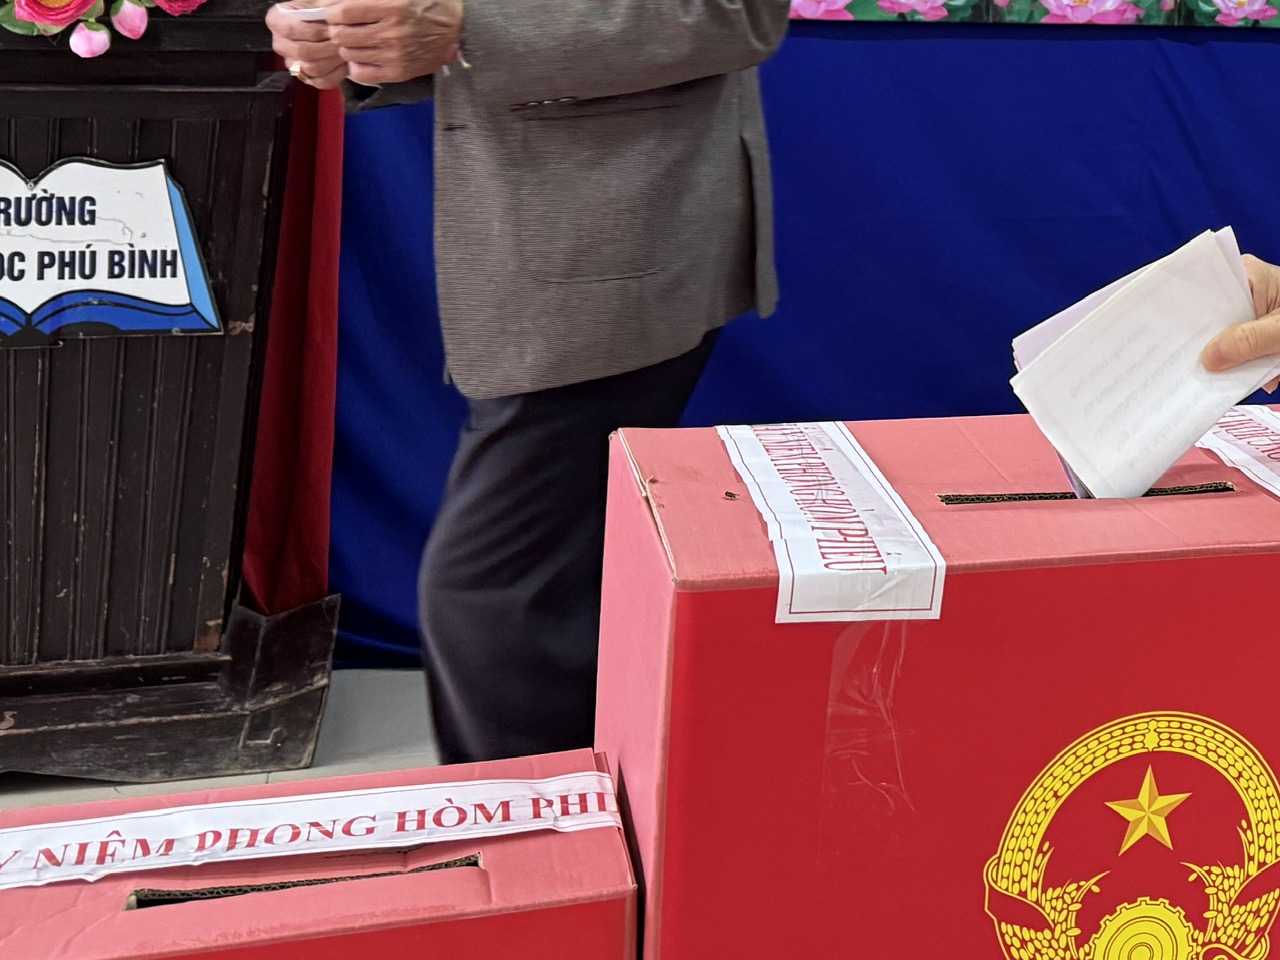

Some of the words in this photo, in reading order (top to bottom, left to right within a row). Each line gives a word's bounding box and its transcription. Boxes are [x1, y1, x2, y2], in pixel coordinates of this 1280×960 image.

[0, 251, 26, 282] C
[36, 243, 97, 281] PHÚ
[107, 243, 178, 279] BÌNH
[773, 461, 846, 495] PHONG
[794, 498, 876, 524] HÒM
[810, 526, 902, 575] PHIẾU
[194, 814, 377, 853] PHONG
[395, 797, 515, 833] HÒM
[528, 791, 618, 821] PHI
